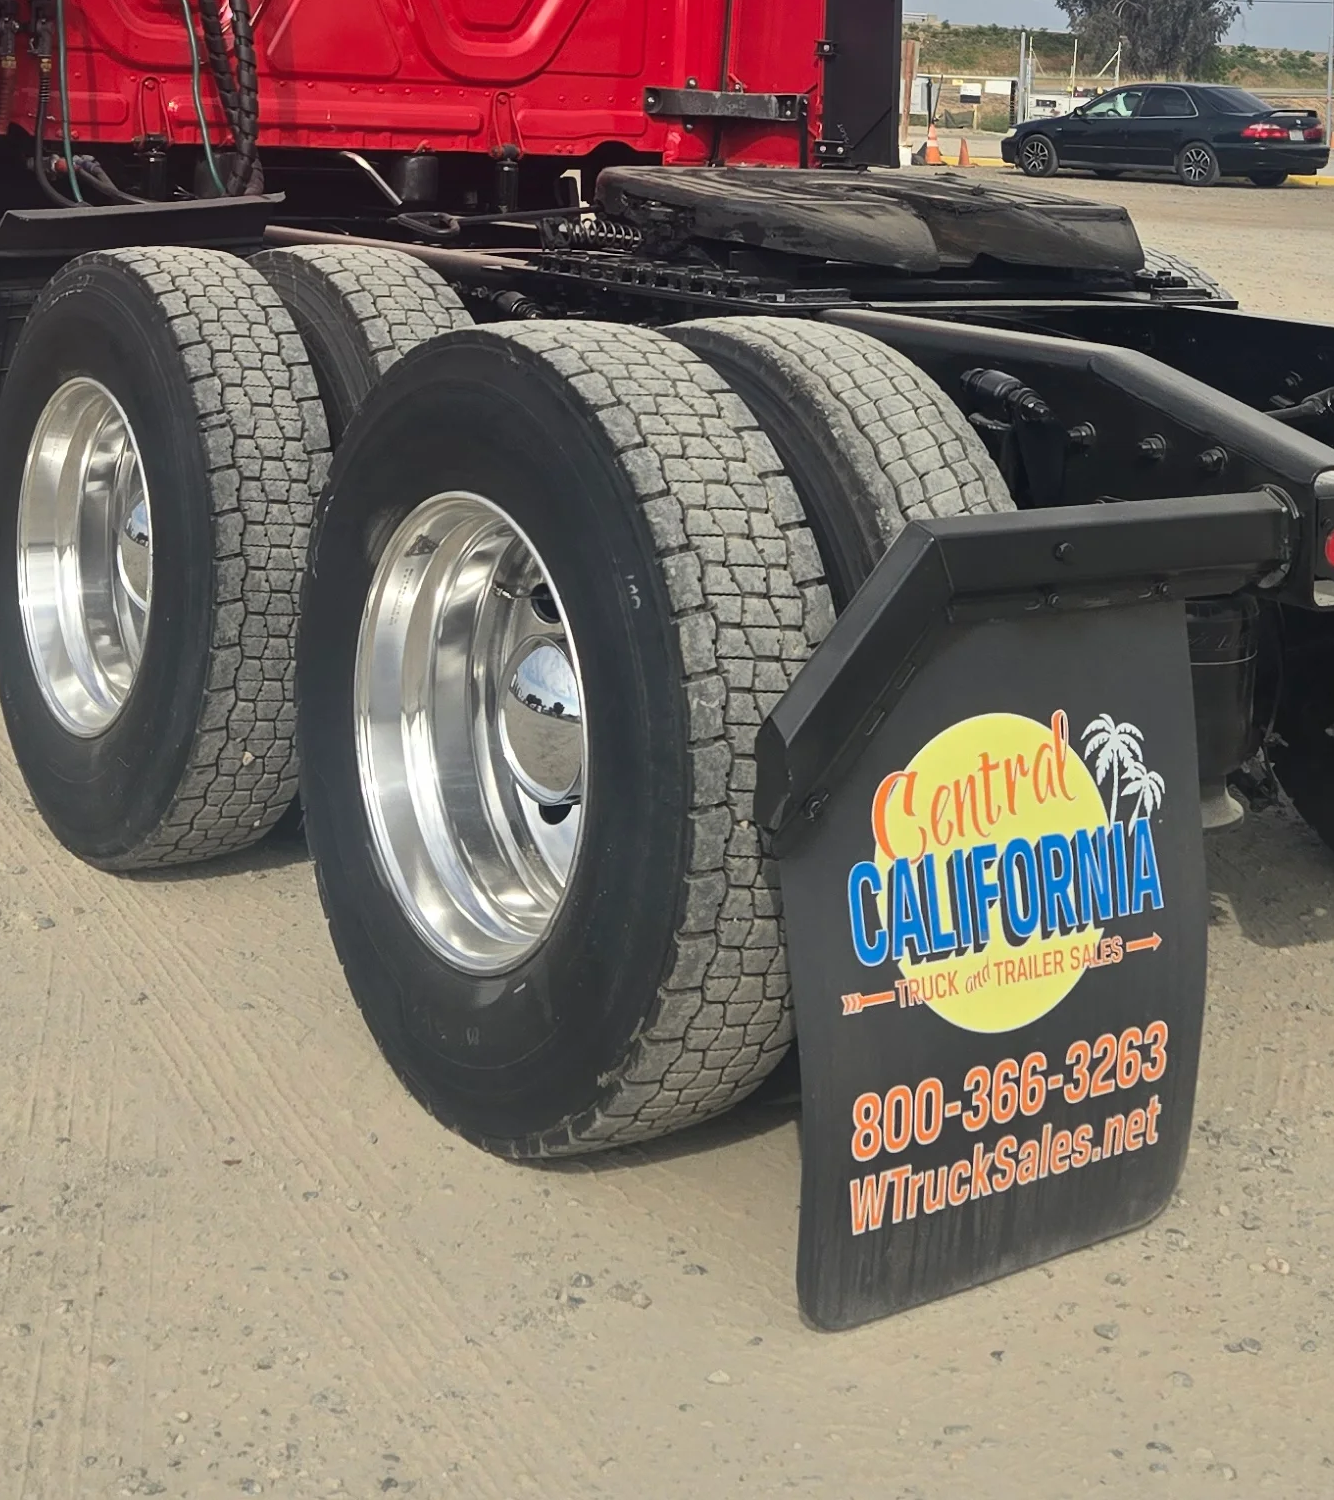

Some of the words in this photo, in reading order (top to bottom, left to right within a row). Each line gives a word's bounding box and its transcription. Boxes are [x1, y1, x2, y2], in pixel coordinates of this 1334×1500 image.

[872, 709, 1077, 865] Central
[847, 816, 1165, 967] CALIFORNIA
[894, 970, 959, 1008] TRUCK
[965, 959, 992, 994] and
[994, 950, 1065, 987] TRAILER
[1070, 935, 1124, 970] SALES
[850, 1020, 1168, 1162] 800-366-3263
[849, 1094, 1162, 1235] WTruckSales.net
